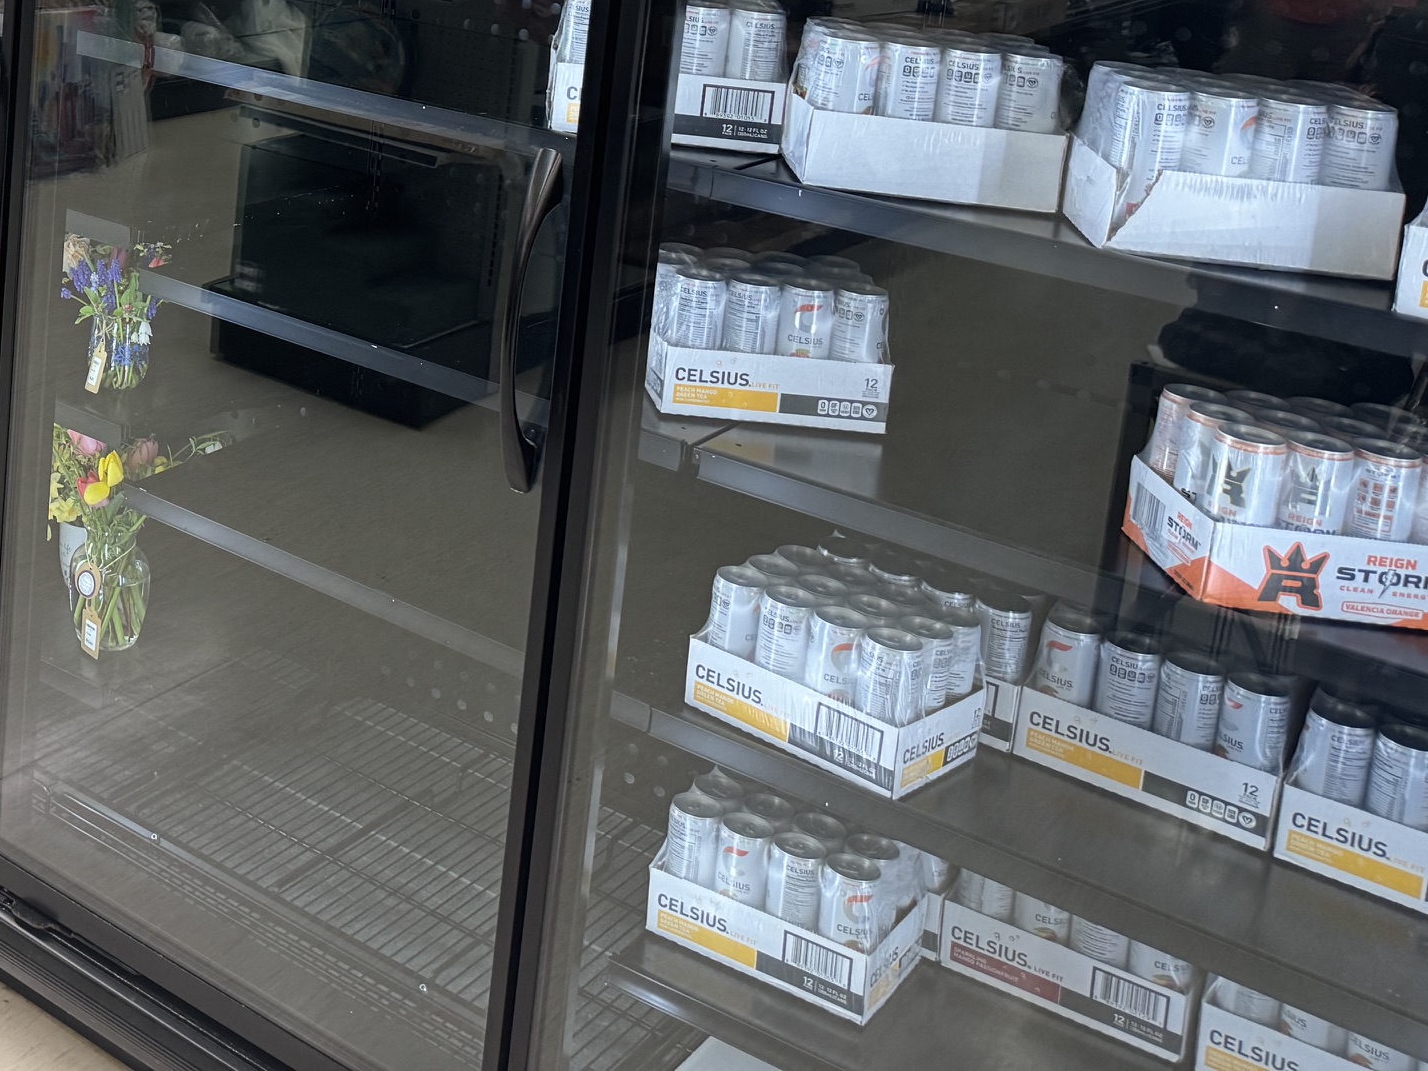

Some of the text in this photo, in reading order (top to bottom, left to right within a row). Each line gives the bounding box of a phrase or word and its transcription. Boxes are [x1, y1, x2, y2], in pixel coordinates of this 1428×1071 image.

[722, 123, 733, 133] 12
[864, 378, 878, 389] 12
[1366, 554, 1418, 571] REIGN
[1339, 584, 1428, 601] CLEAN ENERG
[1345, 603, 1420, 618] VALENCIA ORANGE
[1242, 782, 1259, 797] 12
[953, 951, 975, 966] MANGO
[803, 976, 814, 987] 12
[1033, 965, 1050, 977] LIVE
[1051, 973, 1064, 983] FIT
[1113, 1013, 1125, 1024] 12
